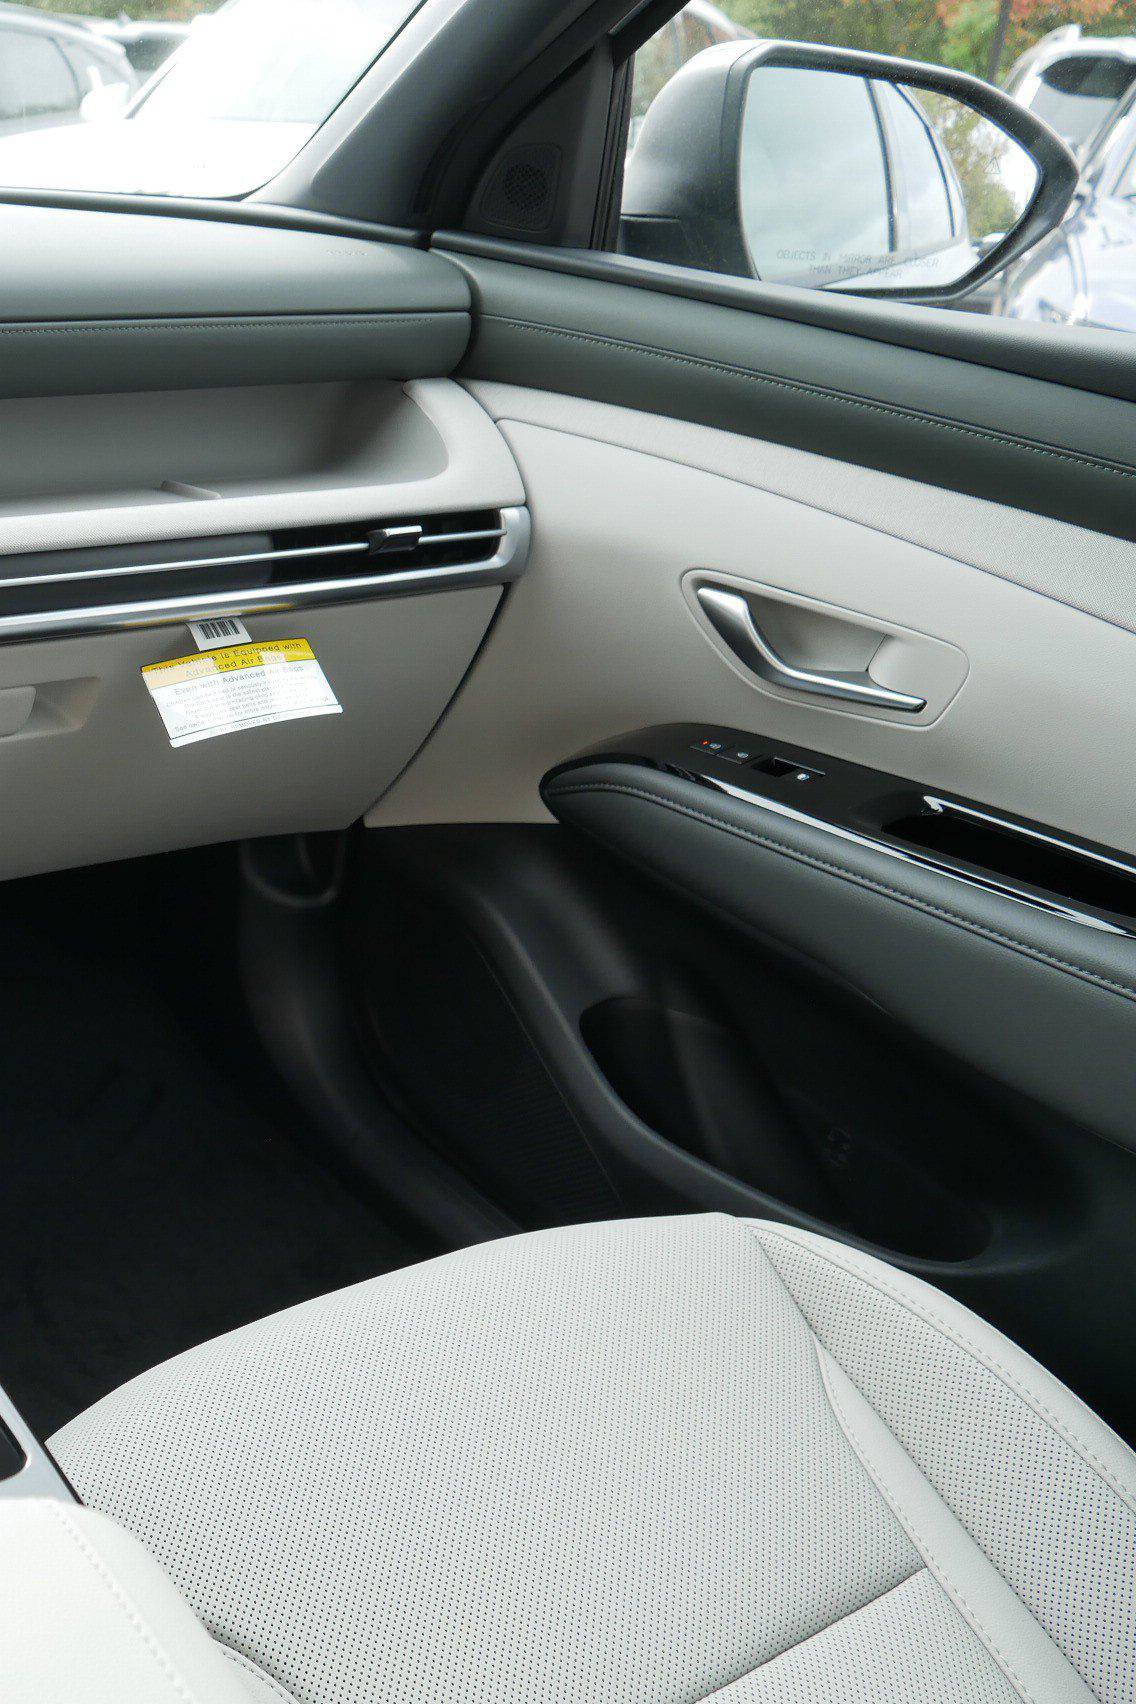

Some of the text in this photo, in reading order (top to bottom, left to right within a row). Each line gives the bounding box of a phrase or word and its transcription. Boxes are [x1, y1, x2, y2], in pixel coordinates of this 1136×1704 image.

[777, 248, 816, 260] OBJECTS
[283, 641, 302, 651] with
[185, 660, 238, 678] Advanced
[241, 656, 256, 668] Air
[173, 684, 201, 695] Even
[222, 670, 266, 684] Advanced
